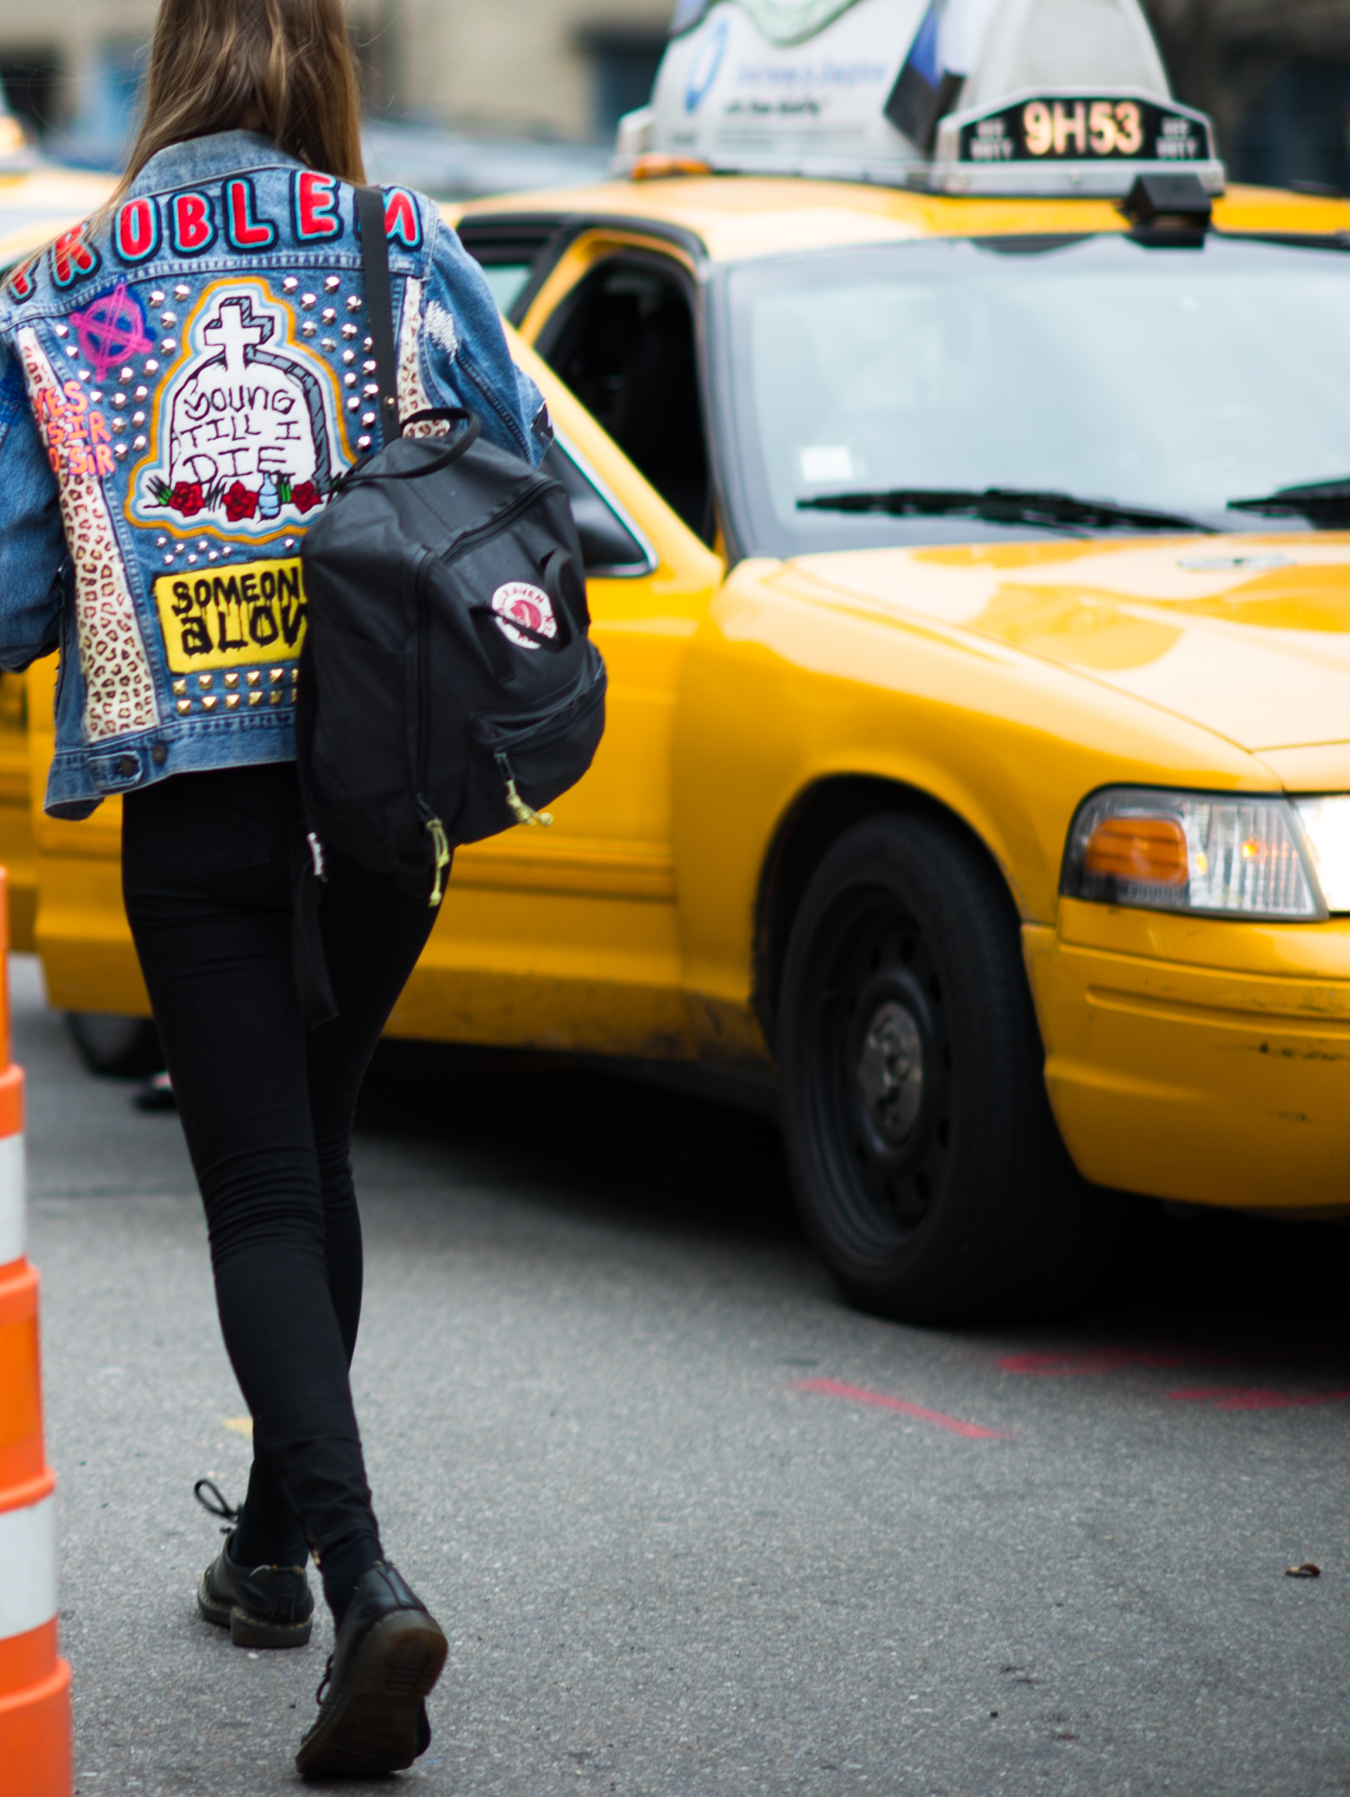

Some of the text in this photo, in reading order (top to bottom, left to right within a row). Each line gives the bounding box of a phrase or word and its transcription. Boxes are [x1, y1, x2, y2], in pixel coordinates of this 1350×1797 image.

[1023, 101, 1142, 156] 9H53
[32, 381, 88, 424] YES
[47, 411, 112, 444] SIR
[180, 414, 302, 448] TILL I
[182, 446, 297, 484] DIE
